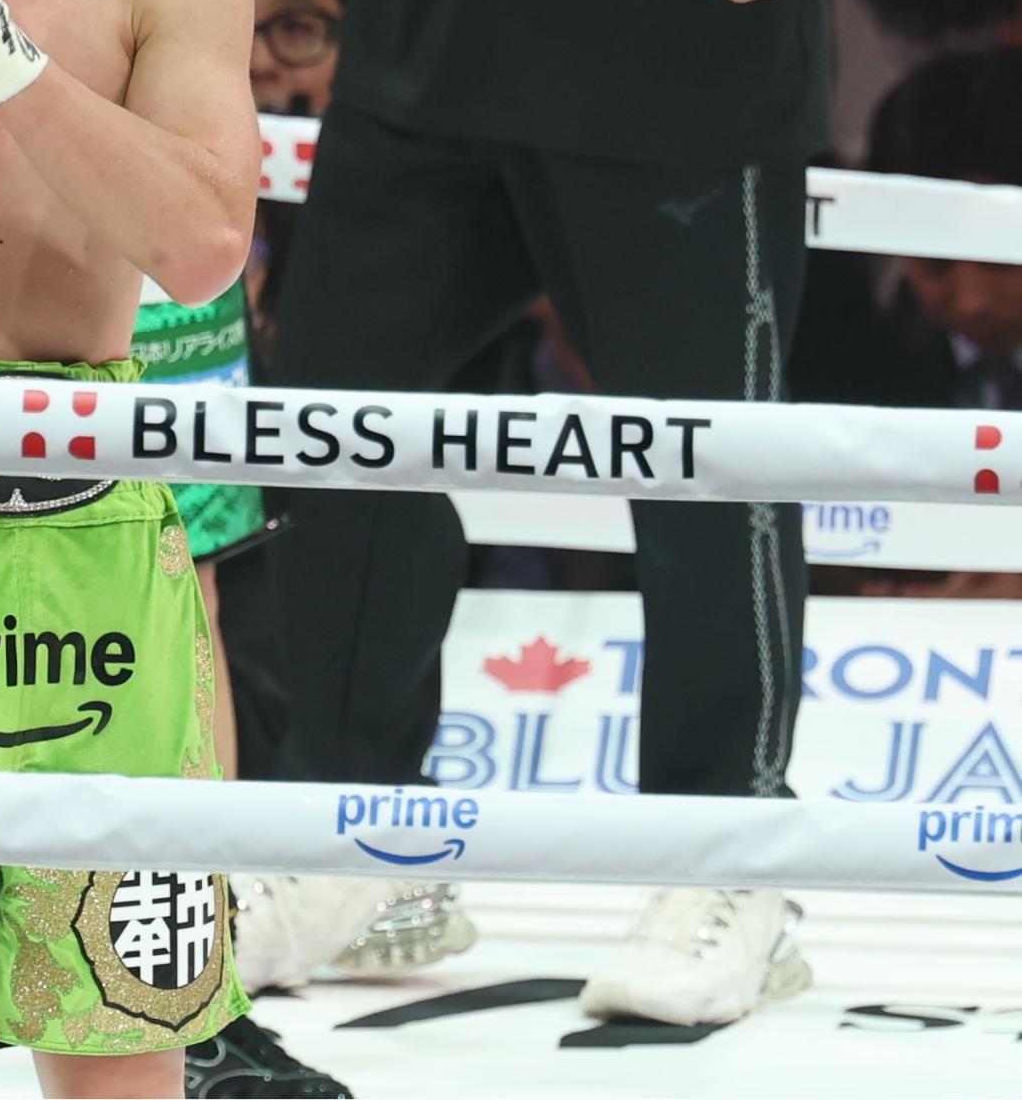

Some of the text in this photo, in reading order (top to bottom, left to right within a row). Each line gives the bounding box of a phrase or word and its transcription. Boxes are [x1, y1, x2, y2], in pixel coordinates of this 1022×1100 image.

[132, 397, 712, 480] BLESS HEART
[803, 502, 890, 533] rime
[337, 788, 479, 836] prime
[918, 805, 1022, 852] prim
